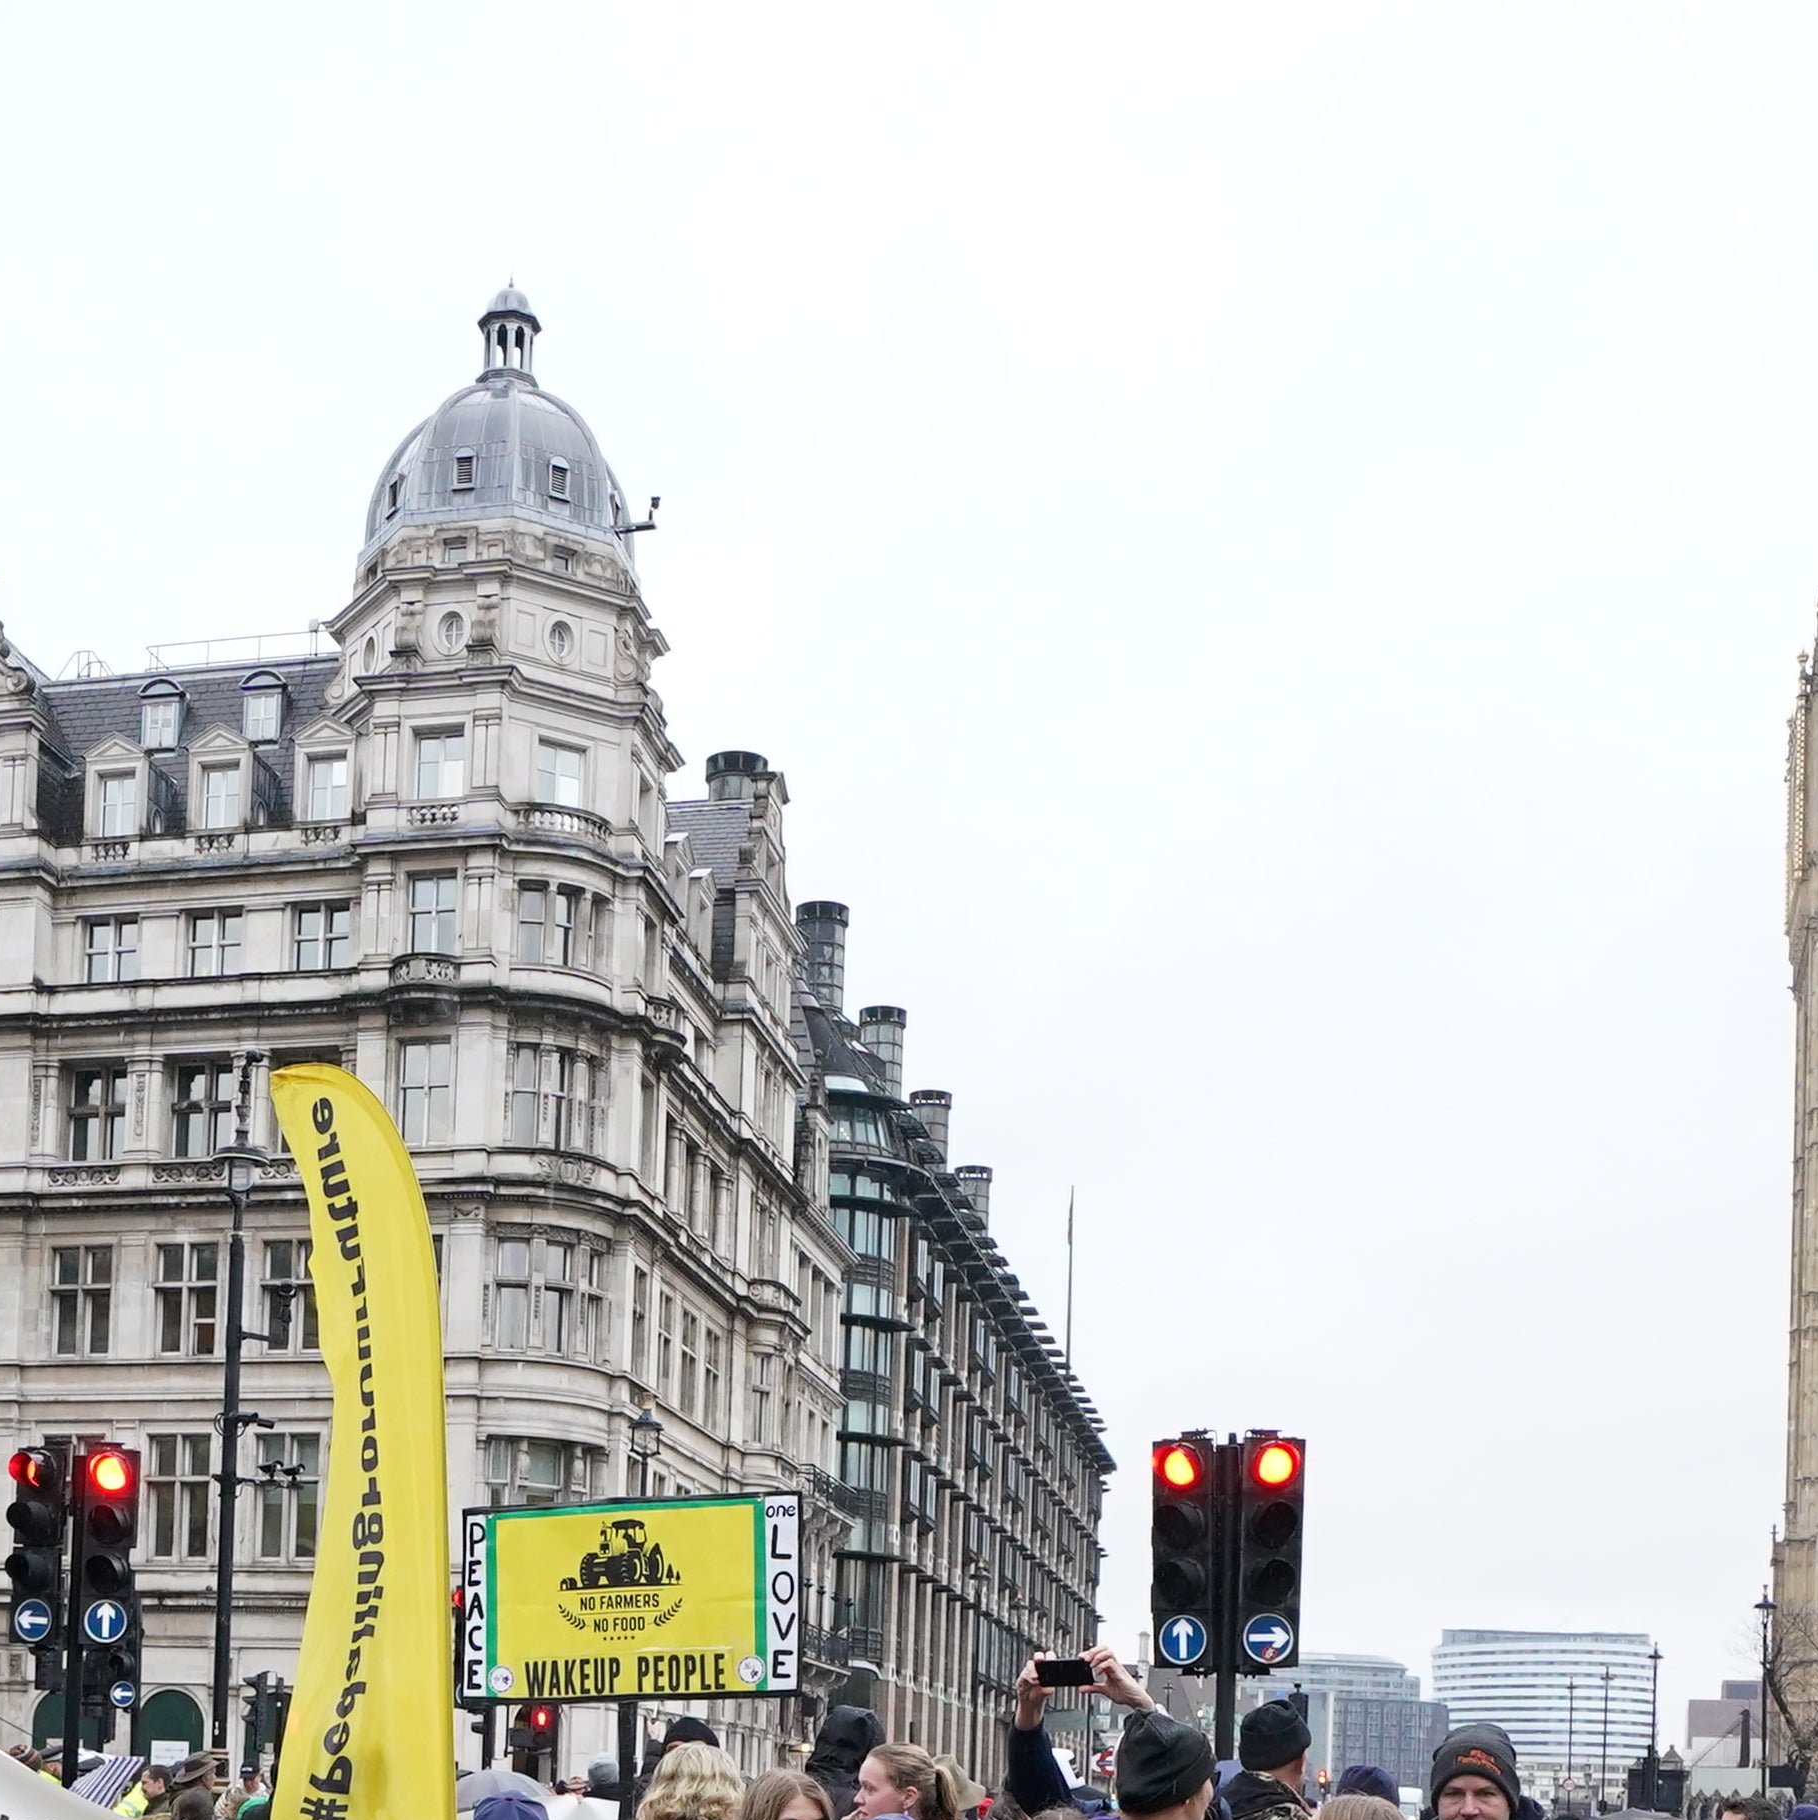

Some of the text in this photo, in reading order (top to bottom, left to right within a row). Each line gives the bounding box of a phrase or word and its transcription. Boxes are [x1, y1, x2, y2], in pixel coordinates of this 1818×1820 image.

[765, 1504, 796, 1518] one
[464, 1522, 485, 1690] PEACE
[580, 1593, 660, 1611] NO FARMERS
[771, 1524, 796, 1678] LOVE
[593, 1616, 645, 1633] NO FOOD
[524, 1653, 726, 1697] WAKEUP PEOPLE
